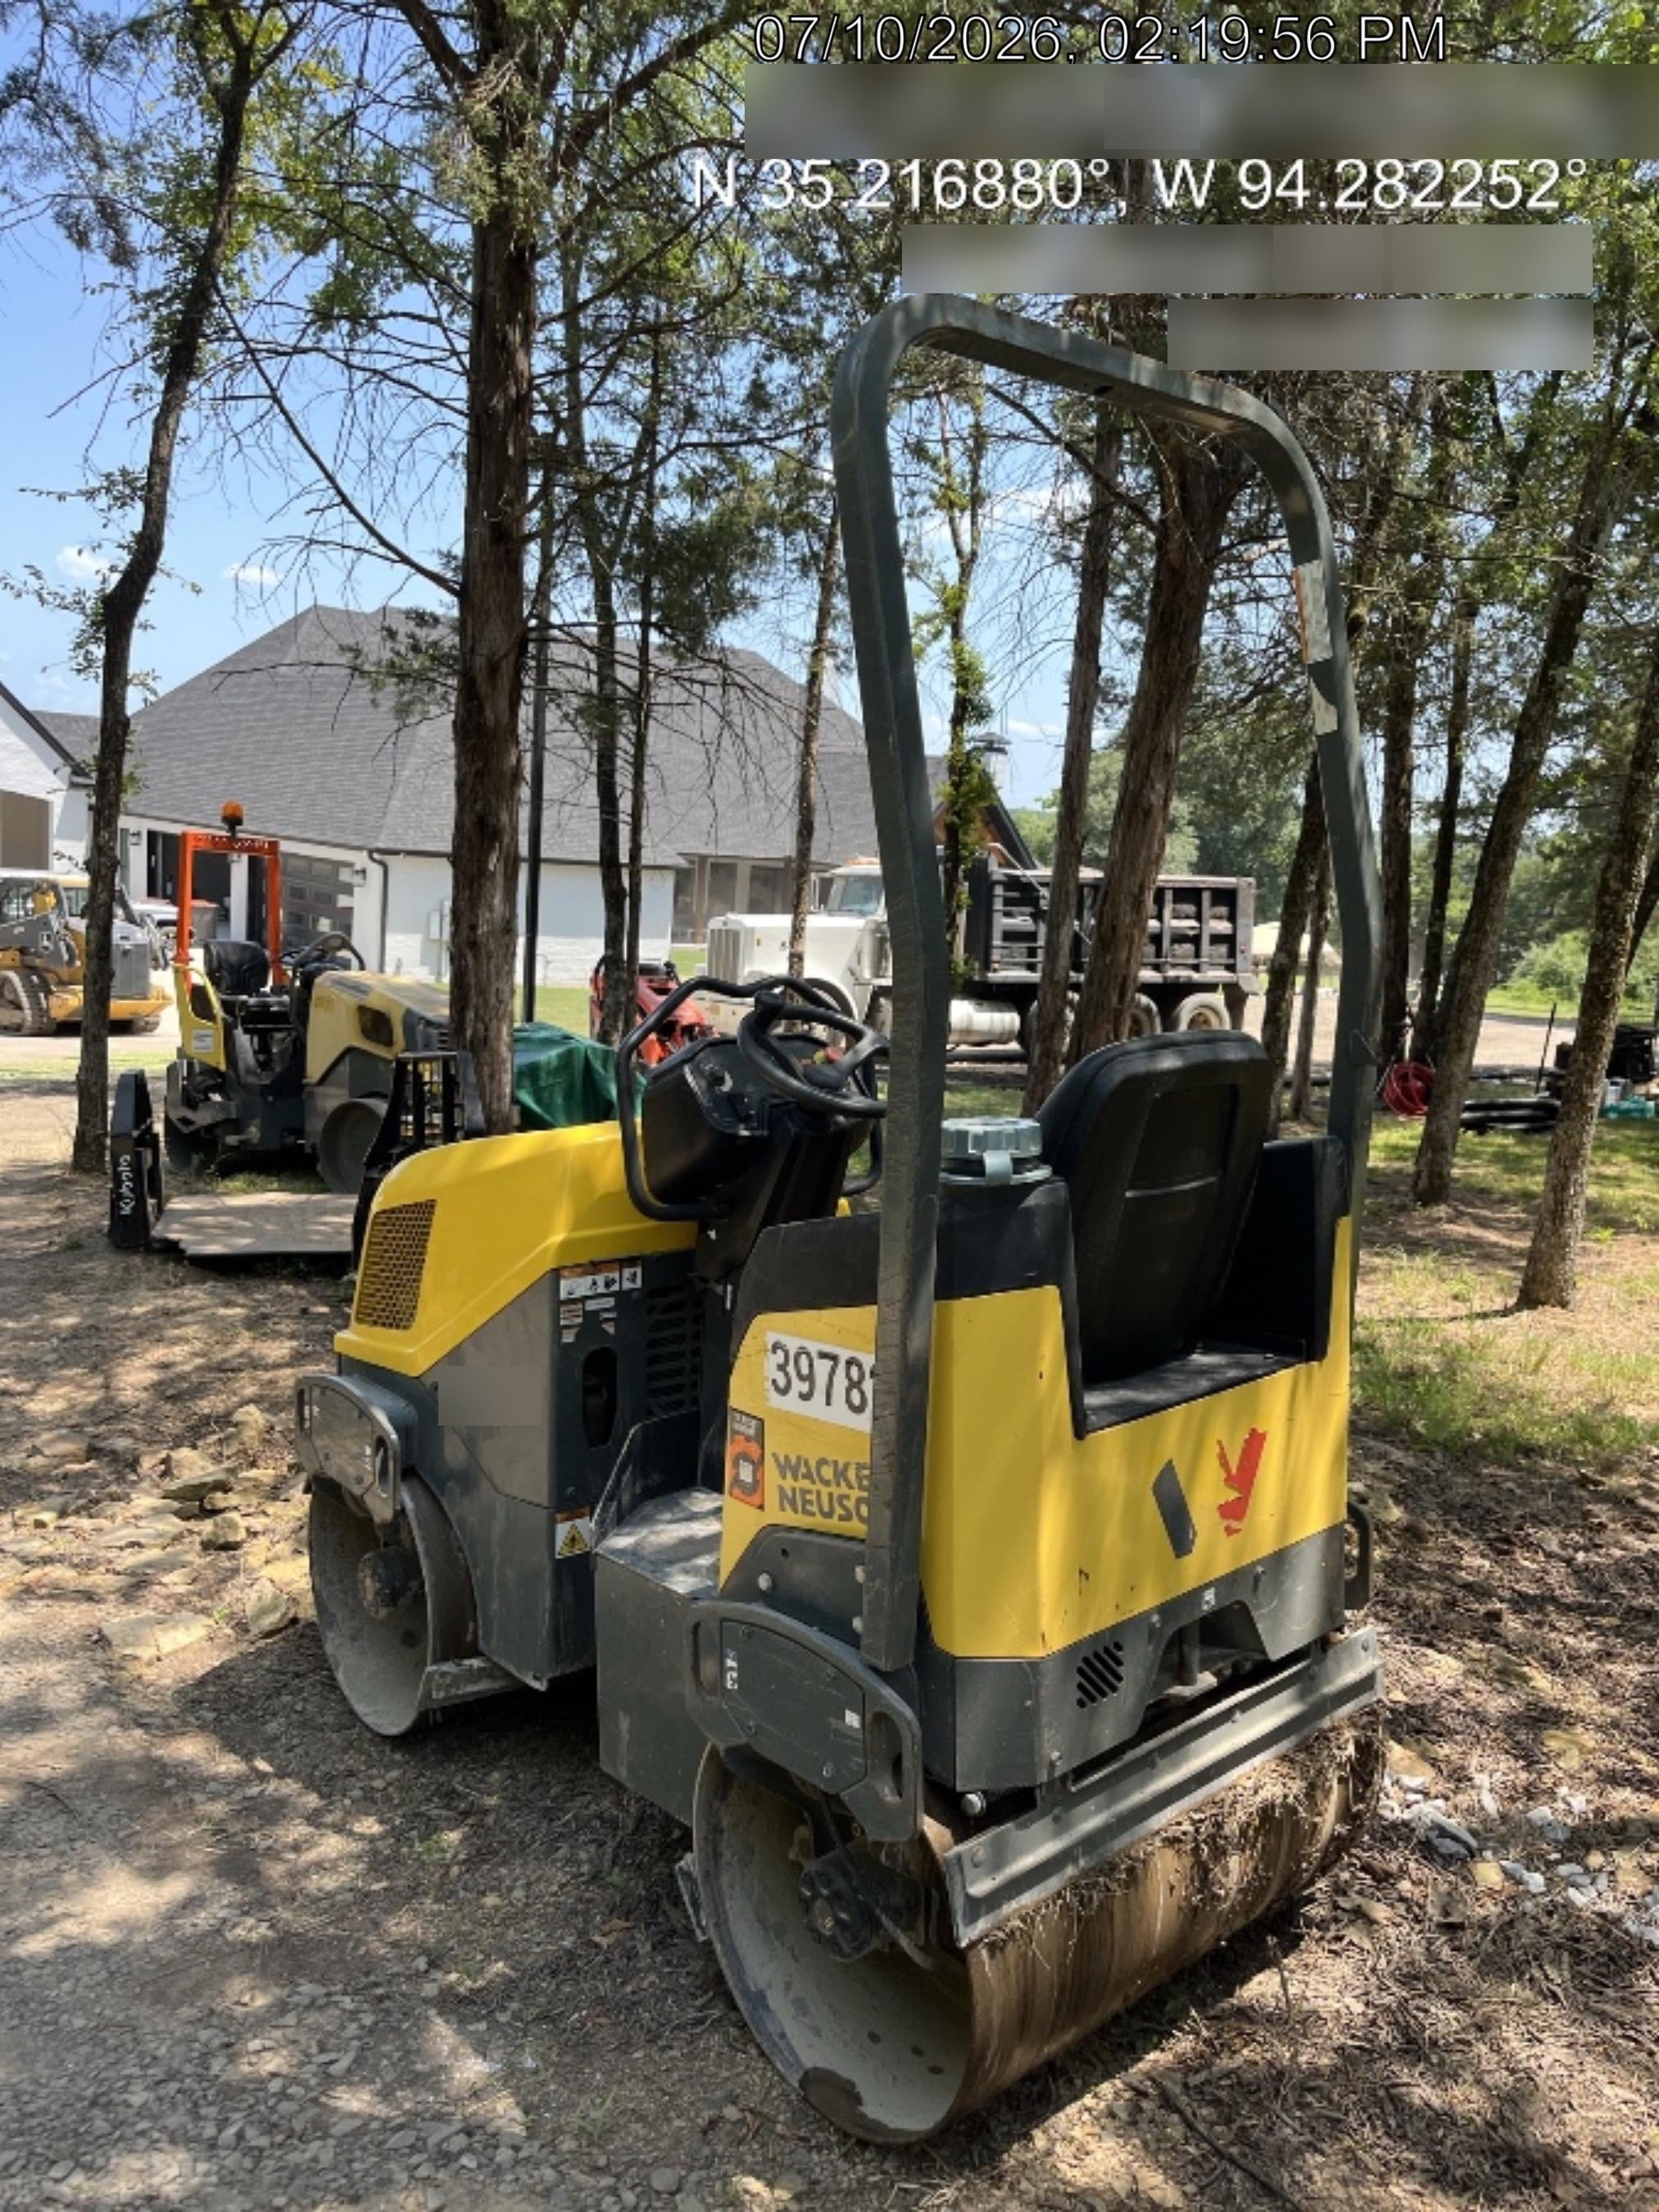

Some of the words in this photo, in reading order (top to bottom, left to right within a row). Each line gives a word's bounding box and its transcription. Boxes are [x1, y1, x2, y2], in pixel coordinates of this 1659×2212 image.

[770, 1339, 877, 1415] 3978
[772, 1452, 871, 1492] WACKE
[777, 1484, 869, 1522] NEUSO
